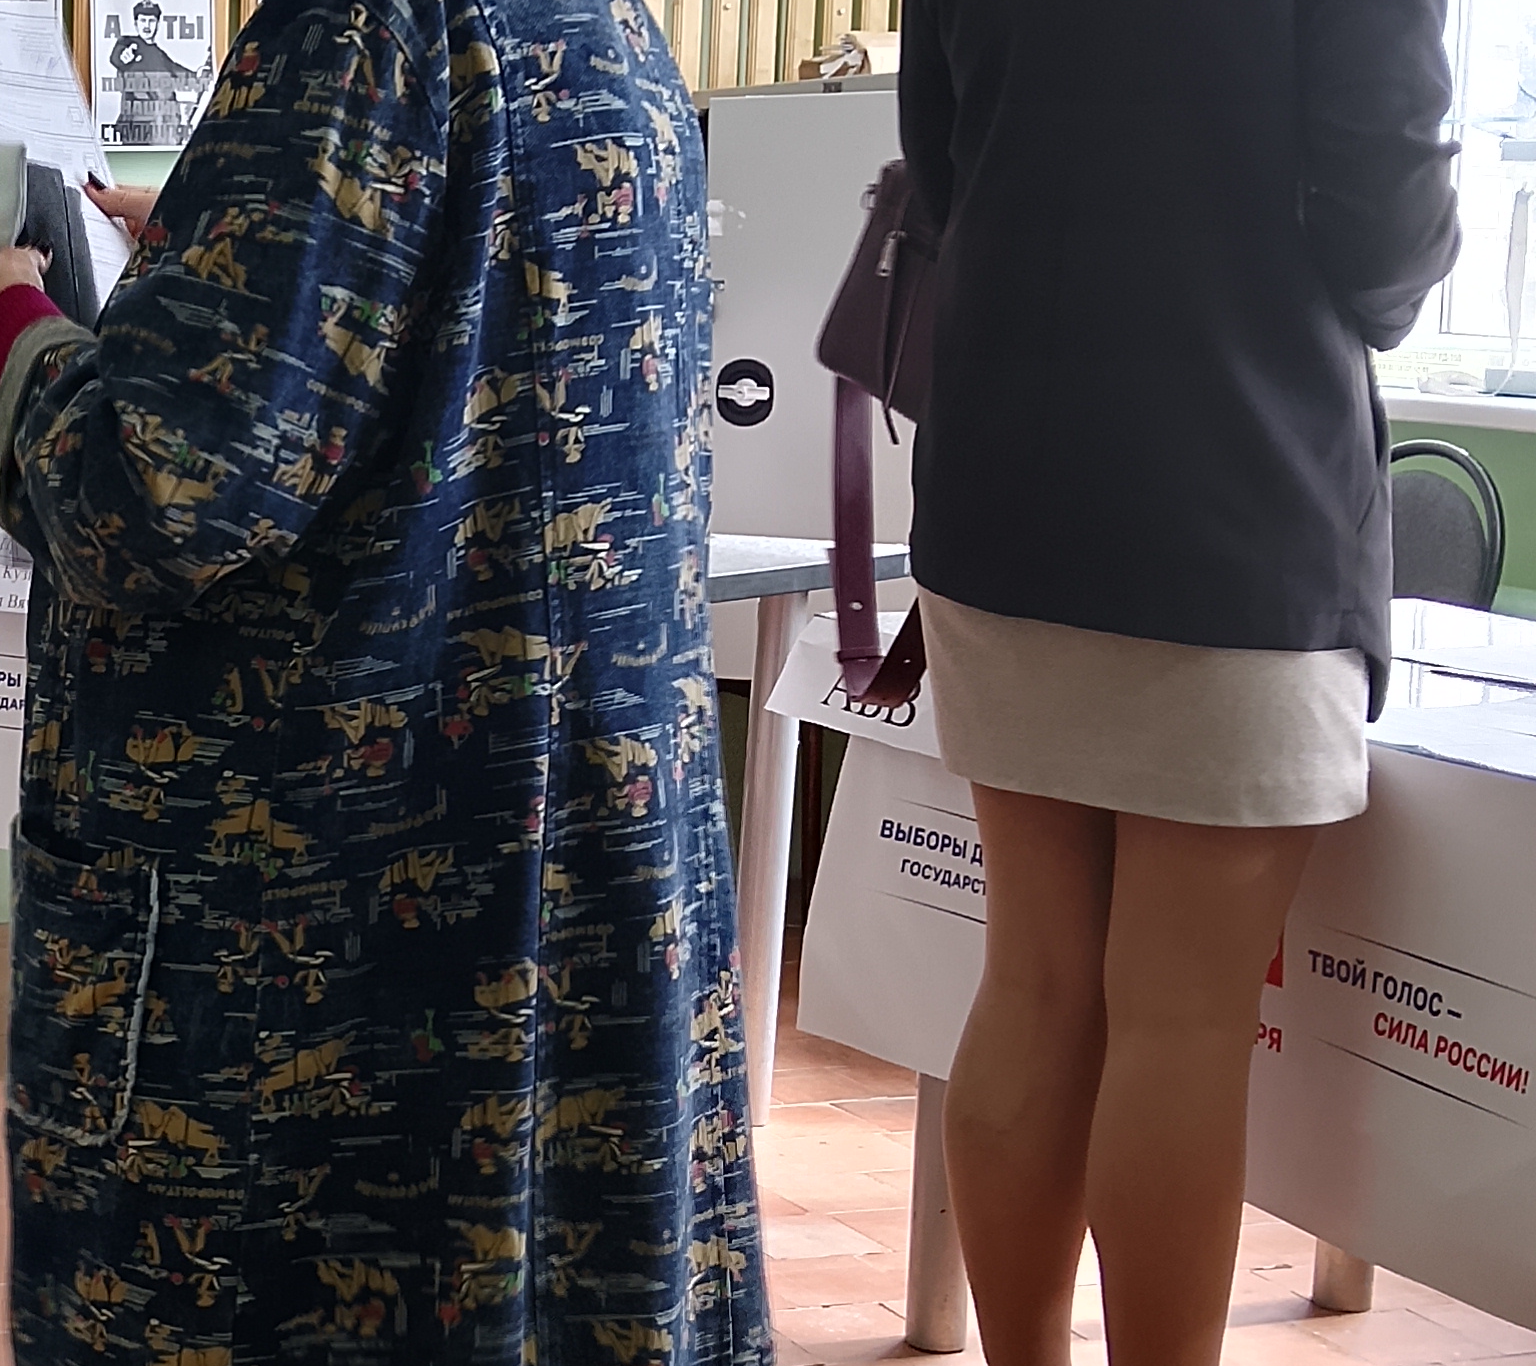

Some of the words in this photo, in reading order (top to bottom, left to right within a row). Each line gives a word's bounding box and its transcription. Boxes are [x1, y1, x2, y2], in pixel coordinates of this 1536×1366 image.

[103, 14, 122, 39] А
[163, 15, 204, 40] ТЫ
[7, 593, 29, 609] Вя
[879, 818, 967, 859] ВЫБОРЫ
[1308, 949, 1367, 990] ТВОЙ
[1371, 971, 1443, 1017] ГОЛОС
[1373, 1012, 1429, 1054] СИЛА
[1433, 1035, 1530, 1095] РОССИИ!
